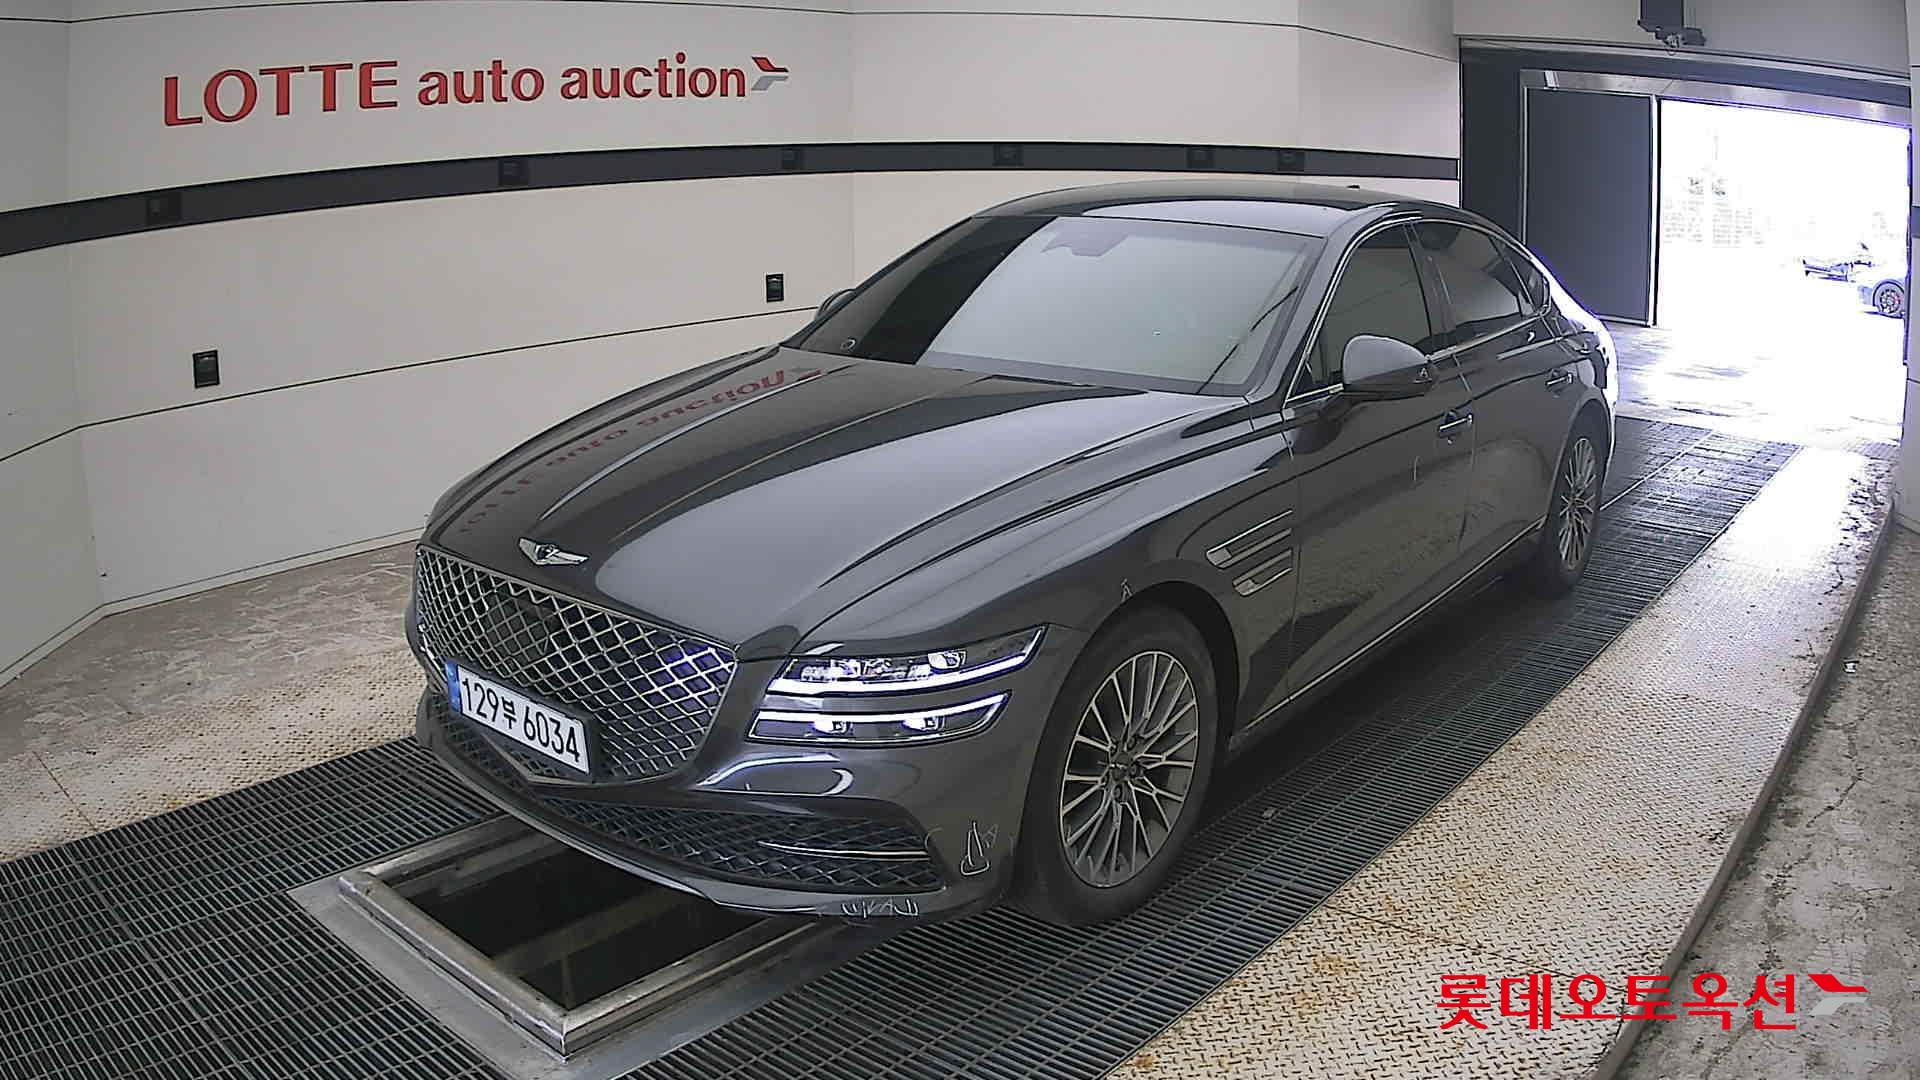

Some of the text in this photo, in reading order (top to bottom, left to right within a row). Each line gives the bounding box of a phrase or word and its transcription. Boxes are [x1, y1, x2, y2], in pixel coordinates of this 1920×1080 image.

[163, 52, 747, 127] LOTTE auto auction
[523, 705, 580, 763] 6034
